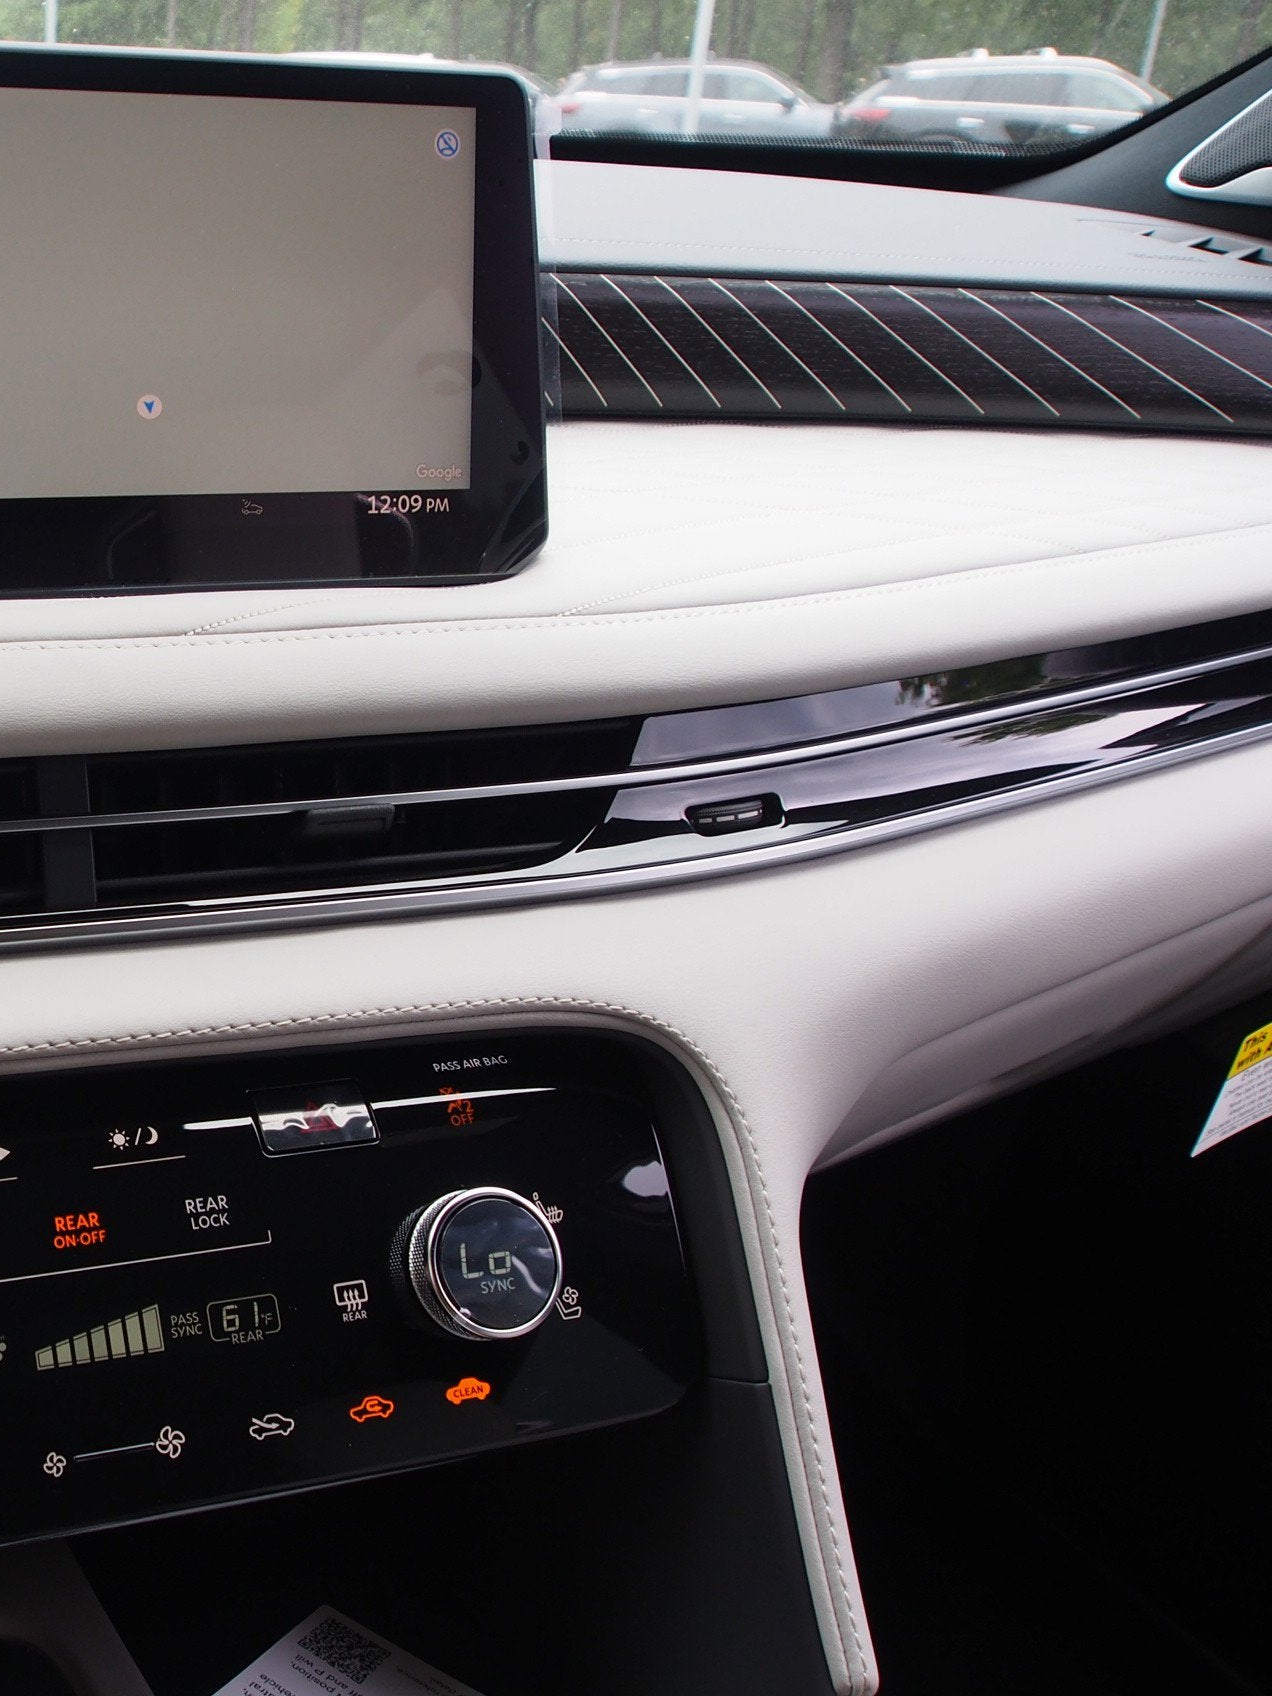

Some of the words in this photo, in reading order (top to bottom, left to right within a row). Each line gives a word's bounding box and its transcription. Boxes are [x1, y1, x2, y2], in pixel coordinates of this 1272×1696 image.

[416, 463, 462, 481] Google
[368, 494, 422, 514] 12:09
[426, 497, 450, 513] PM
[432, 1060, 461, 1073] PASS
[463, 1057, 483, 1070] AIR
[482, 1054, 509, 1067] BAG
[450, 1112, 474, 1126] OFF
[184, 1195, 229, 1215] REAR
[54, 1212, 101, 1232] REAR
[190, 1212, 230, 1231] LOCK
[460, 1242, 512, 1279] Lo
[480, 1277, 516, 1294] SYNC
[170, 1311, 200, 1327] PASS
[342, 1310, 368, 1323] REAR
[170, 1323, 203, 1339] SYNC
[231, 1329, 264, 1345] REAR
[453, 1385, 484, 1398] CLEAN
[295, 1653, 314, 1668] will
[259, 1673, 298, 1696] ehicle
[290, 1660, 336, 1693] position.
[326, 1673, 349, 1690] and
